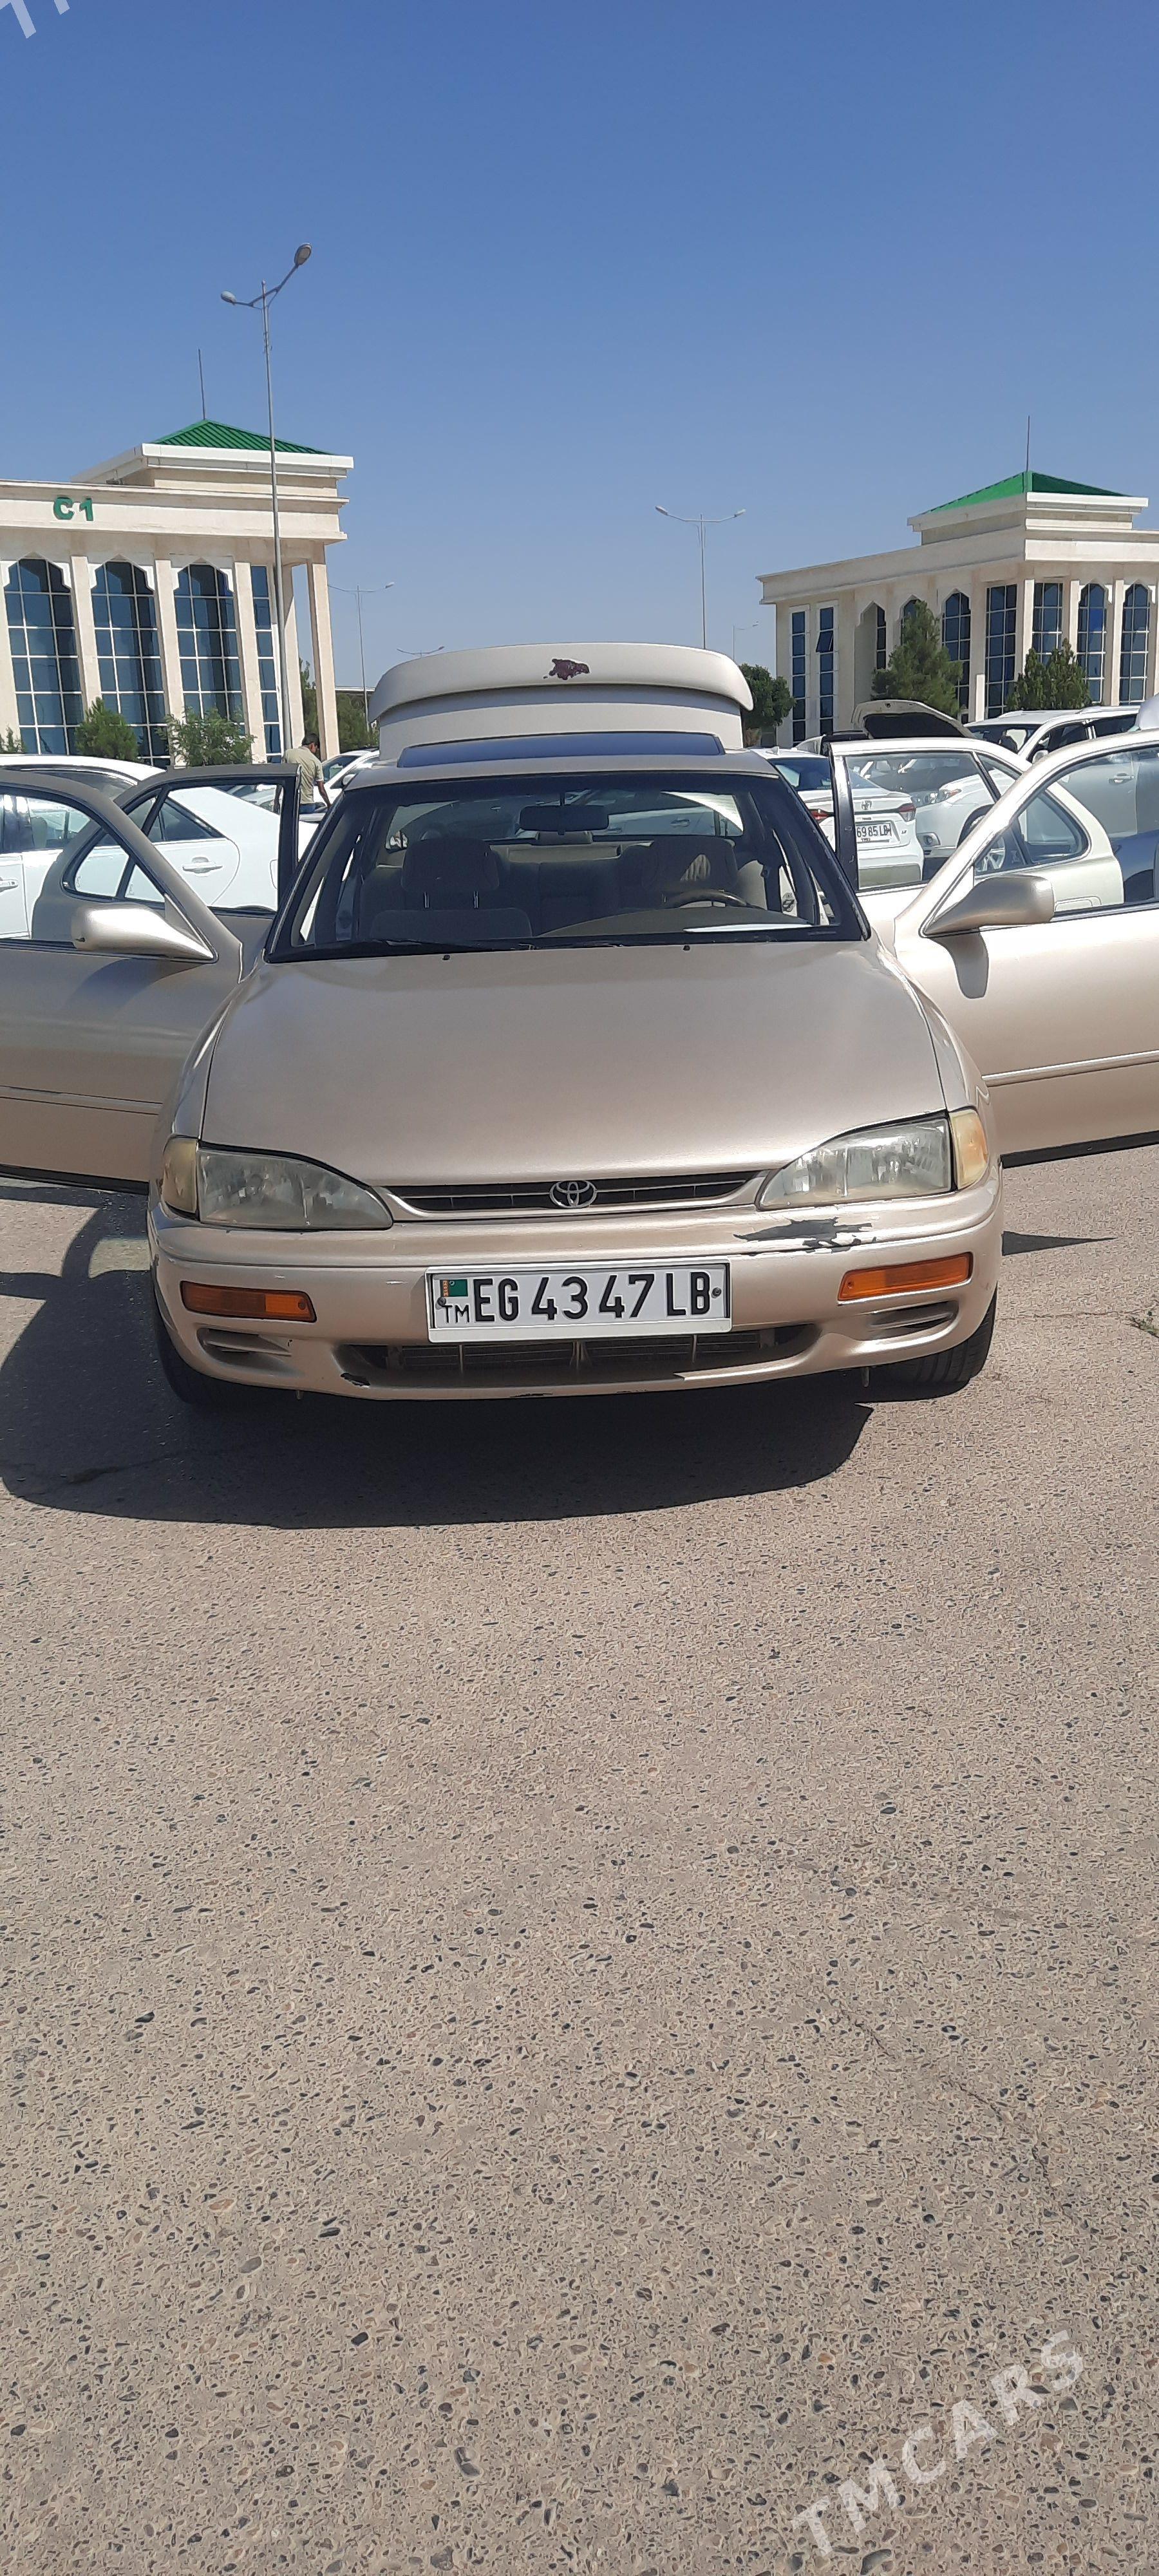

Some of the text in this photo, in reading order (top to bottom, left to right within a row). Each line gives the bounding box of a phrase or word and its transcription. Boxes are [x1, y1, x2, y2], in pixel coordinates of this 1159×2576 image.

[53, 497, 93, 522] C1
[857, 826, 867, 837] 69
[868, 826, 878, 837] 85
[473, 1271, 710, 1321] EG 43 47 LB
[441, 1304, 470, 1323] TM
